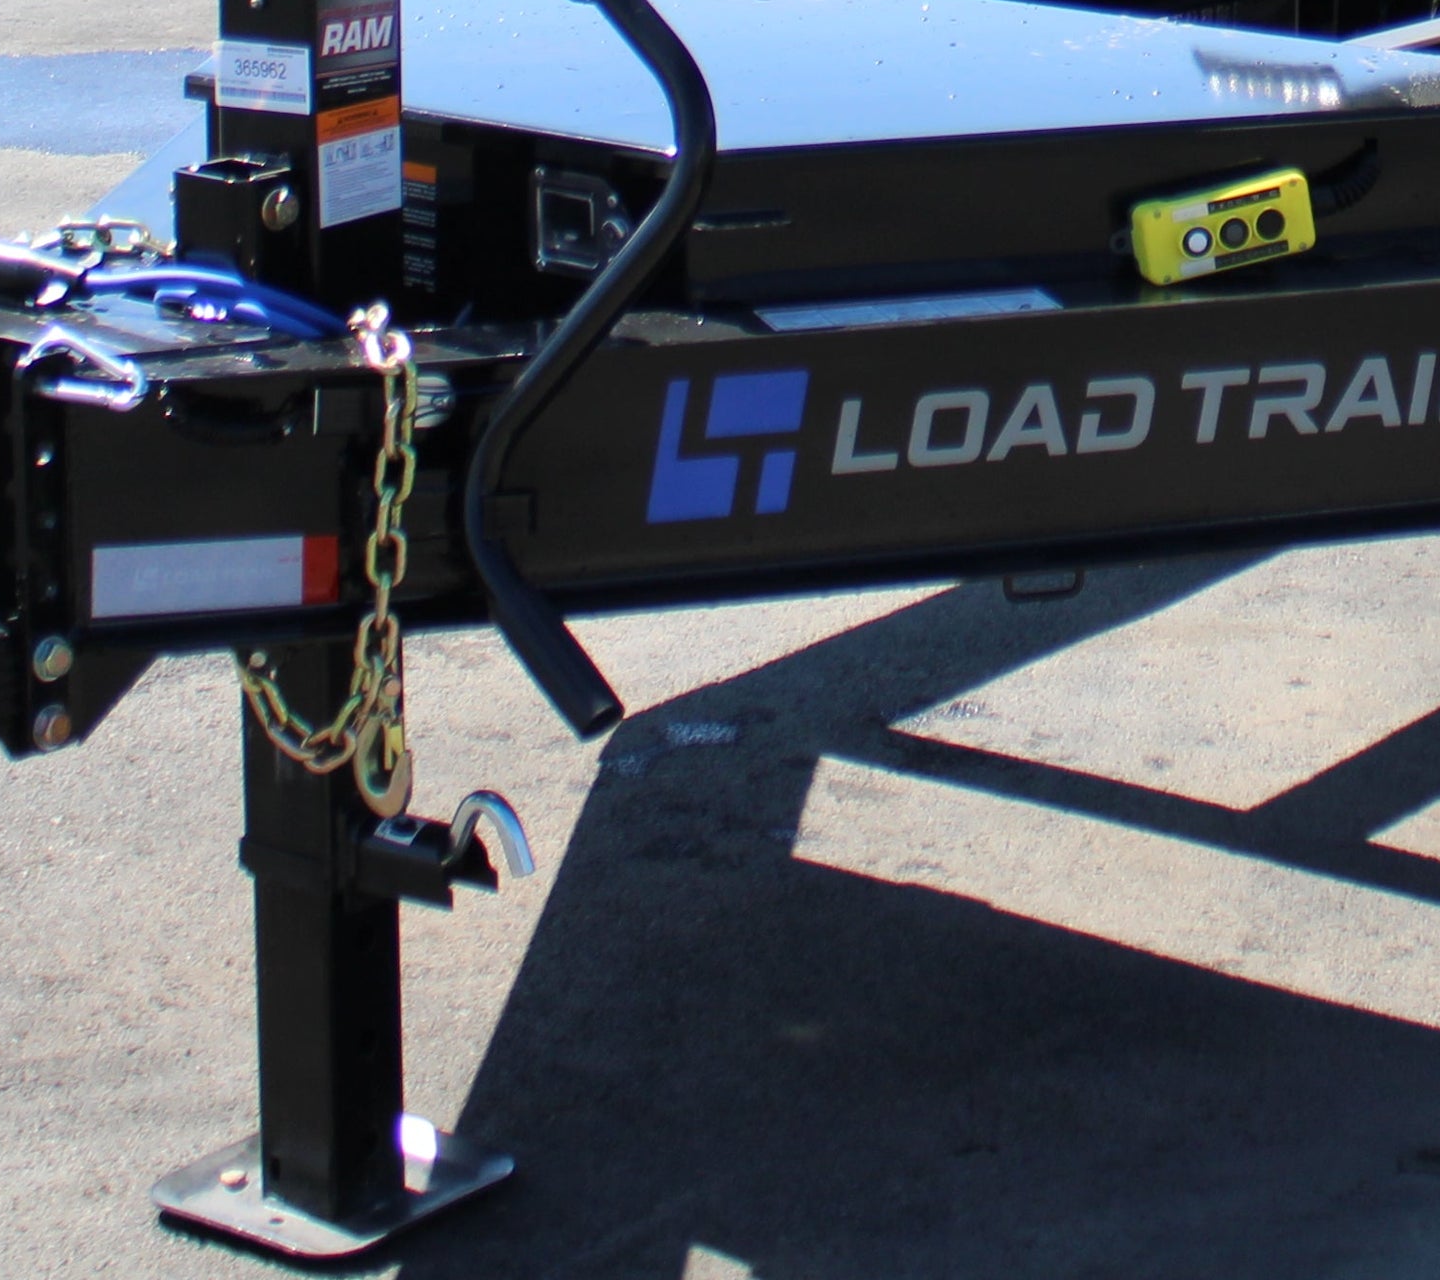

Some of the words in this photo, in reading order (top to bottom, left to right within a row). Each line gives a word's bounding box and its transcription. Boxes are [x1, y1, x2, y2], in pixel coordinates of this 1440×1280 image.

[321, 15, 393, 57] RAM
[234, 58, 288, 80] 365962
[831, 376, 1157, 475] LOAD
